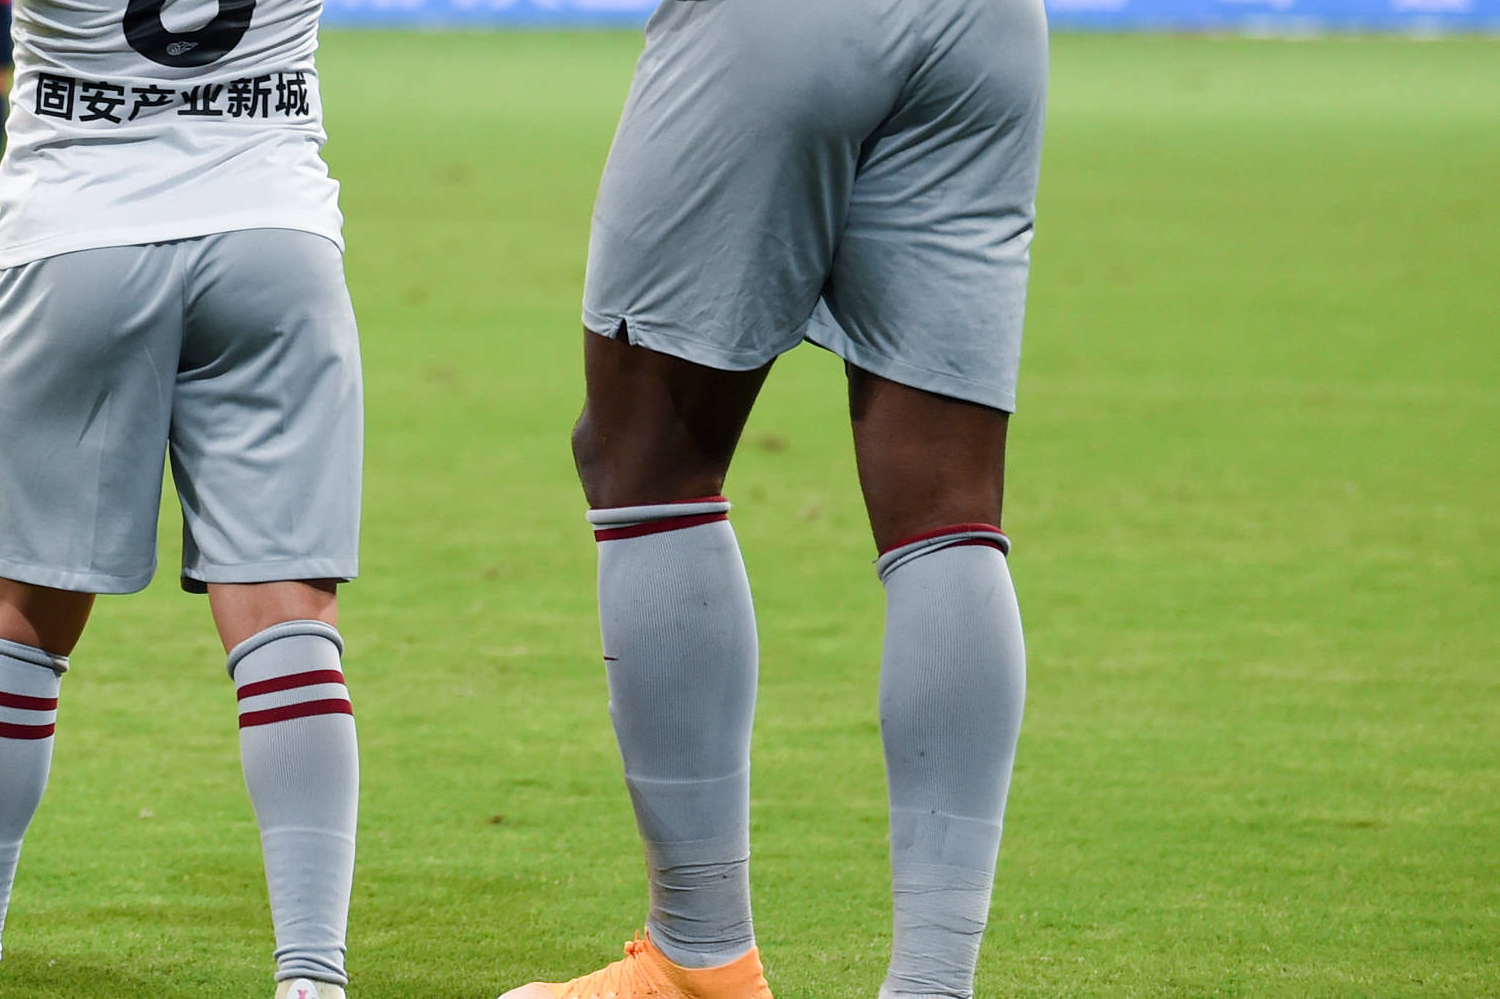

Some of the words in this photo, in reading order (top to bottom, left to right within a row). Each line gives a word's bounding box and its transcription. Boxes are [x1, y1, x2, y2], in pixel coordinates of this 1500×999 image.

[34, 71, 310, 124] 固安产业新城
